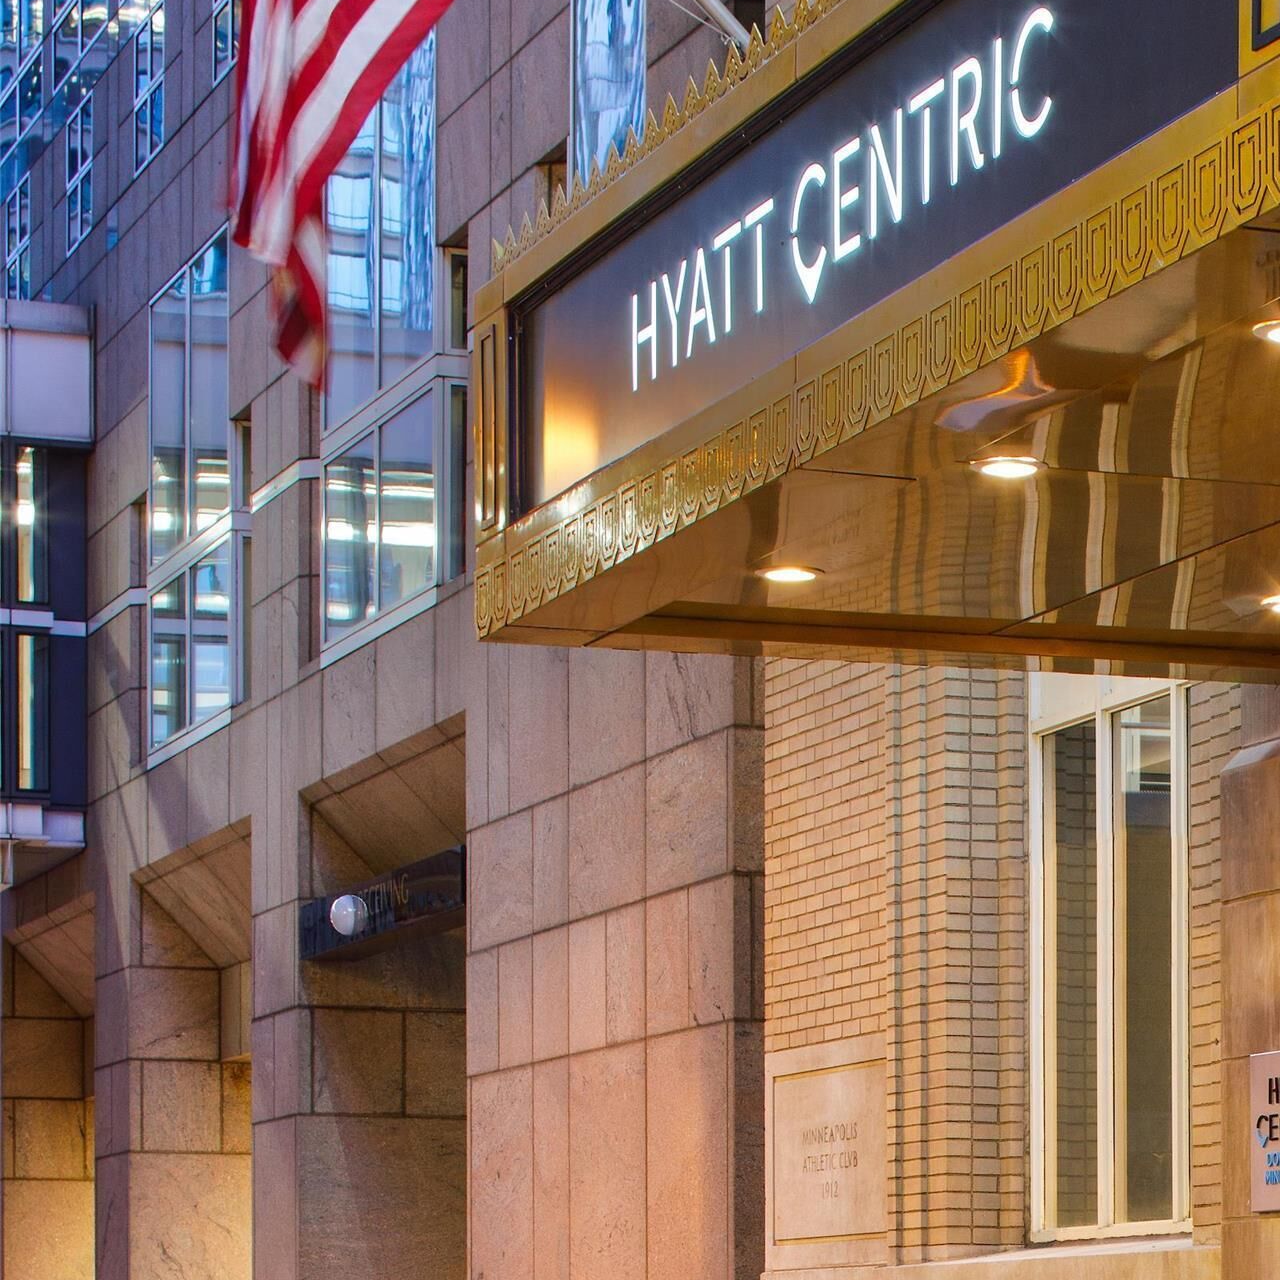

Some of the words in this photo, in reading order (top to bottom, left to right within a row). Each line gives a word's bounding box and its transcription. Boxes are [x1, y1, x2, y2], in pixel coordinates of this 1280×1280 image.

[631, 197, 774, 392] HYATT
[789, 6, 1055, 305] CENTRIC
[802, 1122, 858, 1145] MINNEAPOLIS
[803, 1153, 837, 1173] ATHLETIC
[822, 1181, 840, 1199] 1912
